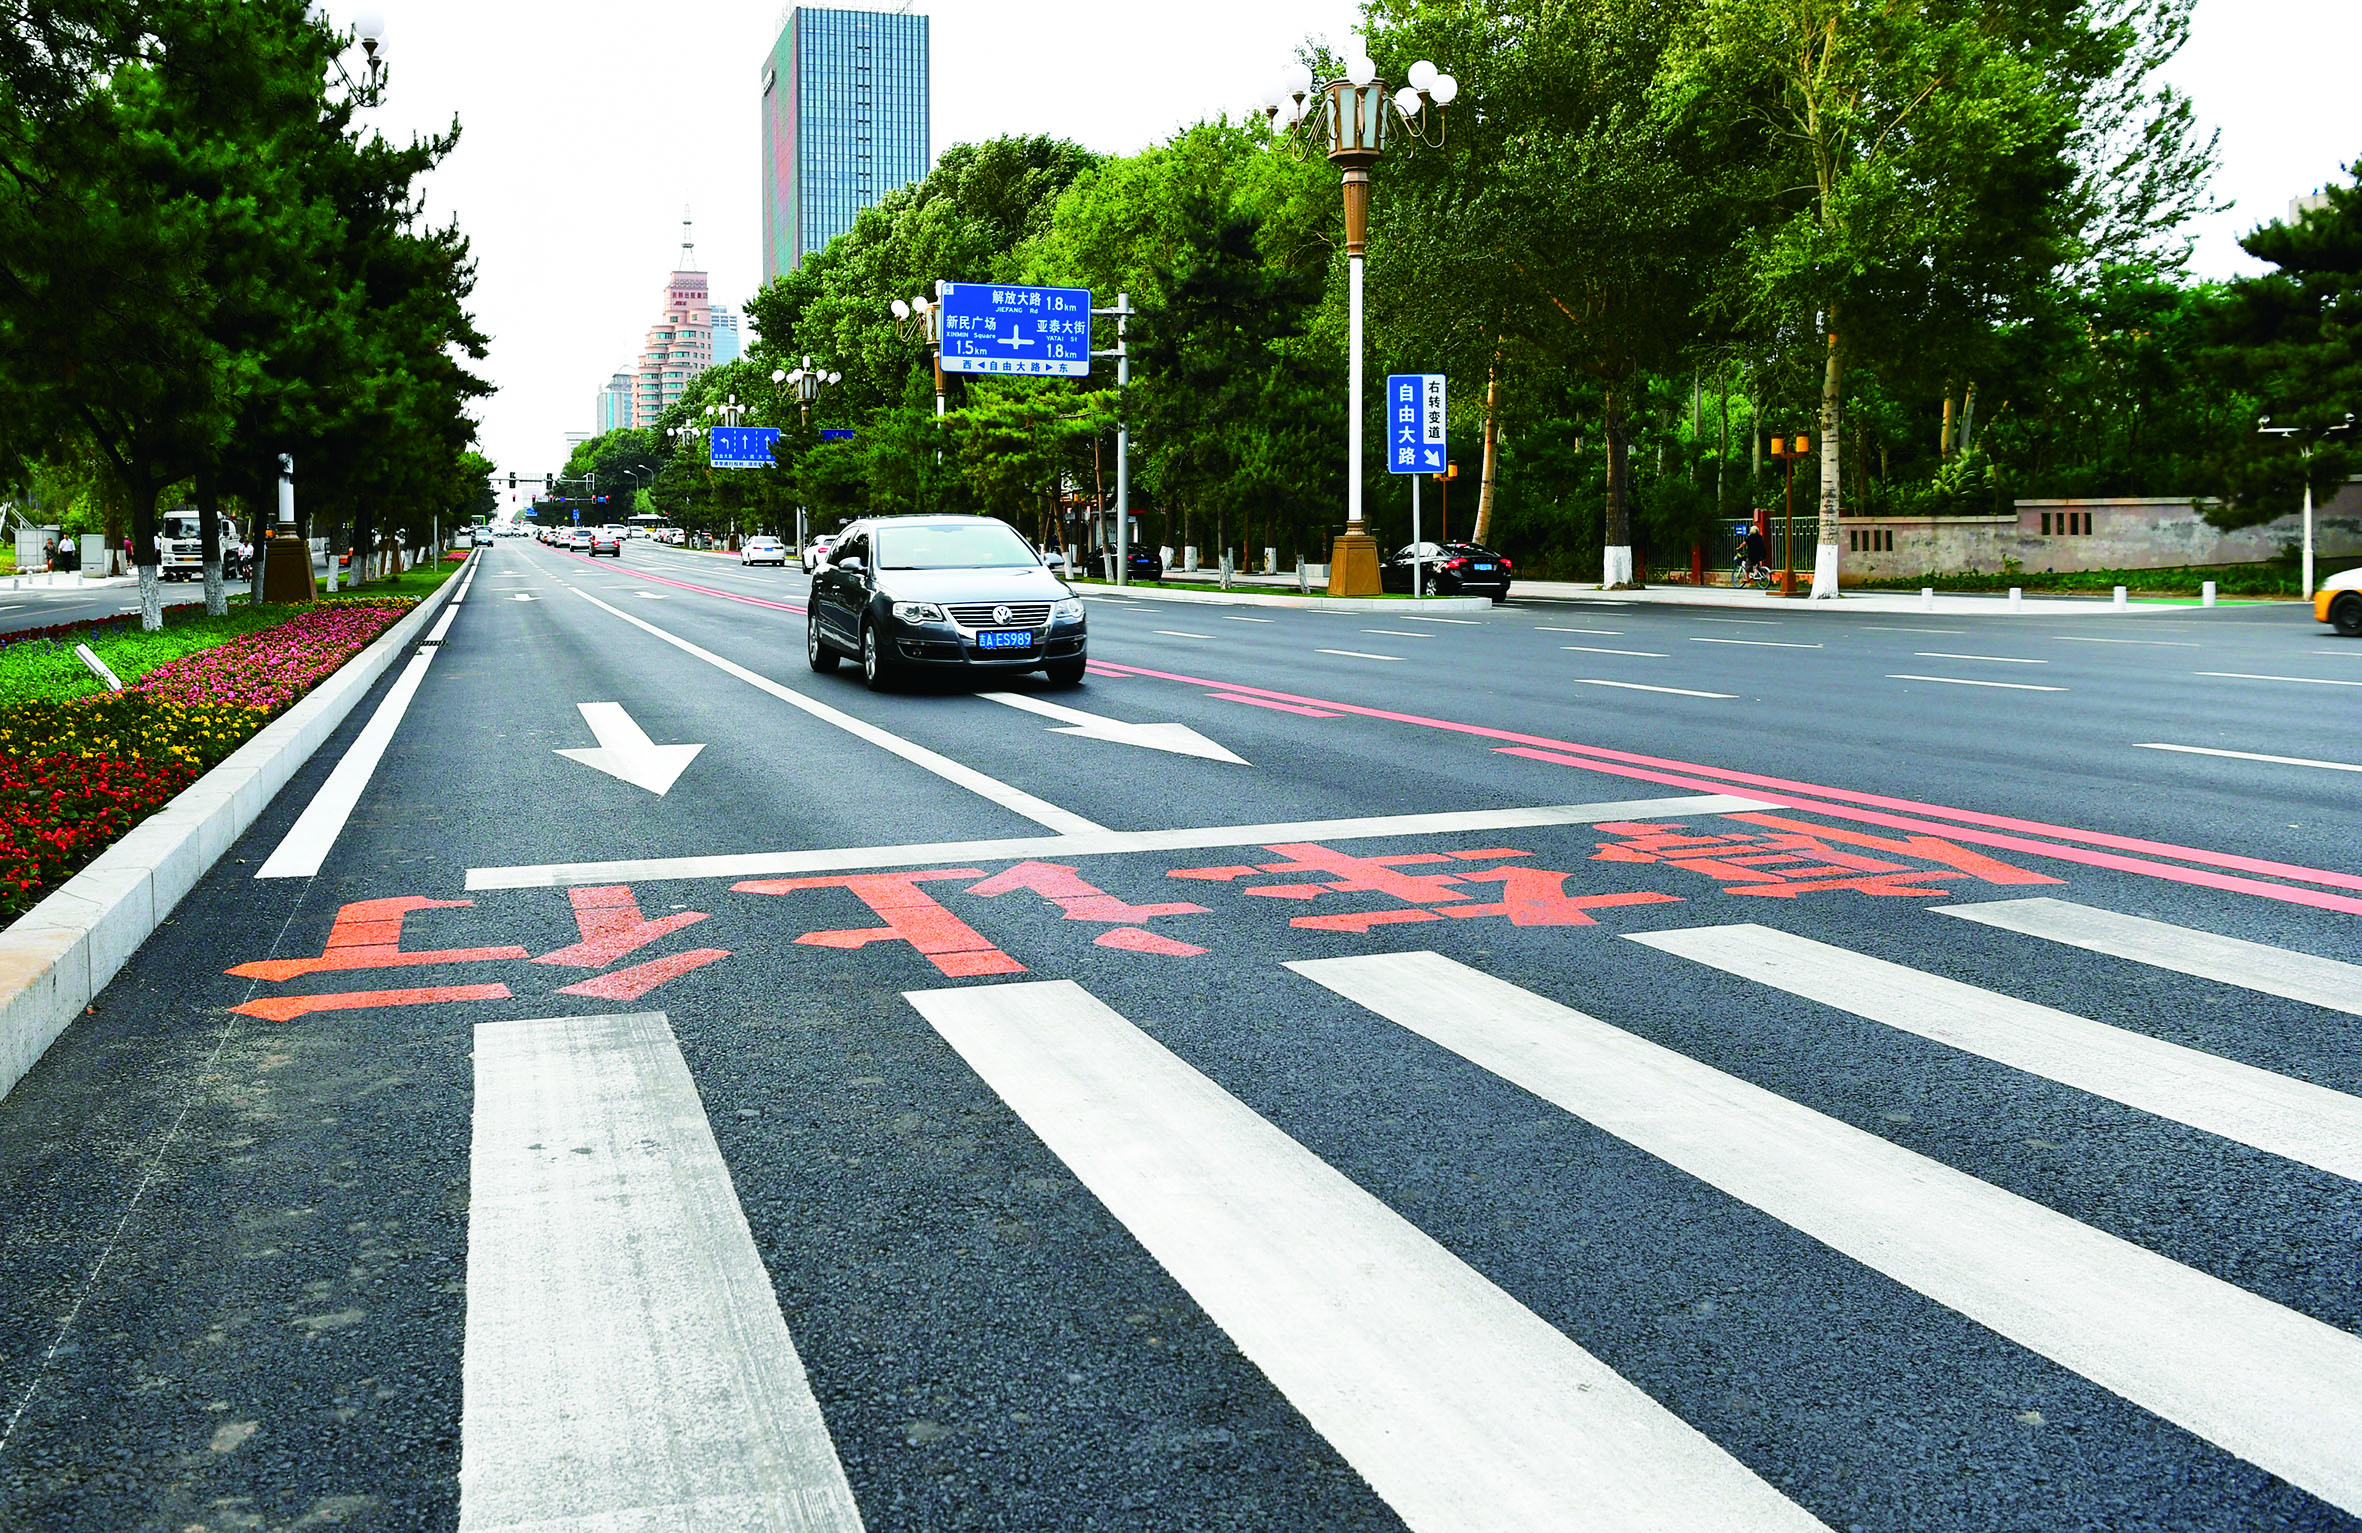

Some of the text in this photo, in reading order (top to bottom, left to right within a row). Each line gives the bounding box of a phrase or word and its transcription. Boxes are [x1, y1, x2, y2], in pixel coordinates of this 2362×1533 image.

[991, 290, 1042, 307] 解放大路
[995, 306, 1023, 314] JIEFANG
[946, 314, 997, 331] 新民广场
[1036, 319, 1086, 335] 亚泰大街
[962, 359, 1068, 373] 西 自由大路 东
[1428, 380, 1441, 439] 右转变道
[1398, 383, 1416, 465] 自由大路
[225, 813, 2066, 1022] 停车让行
